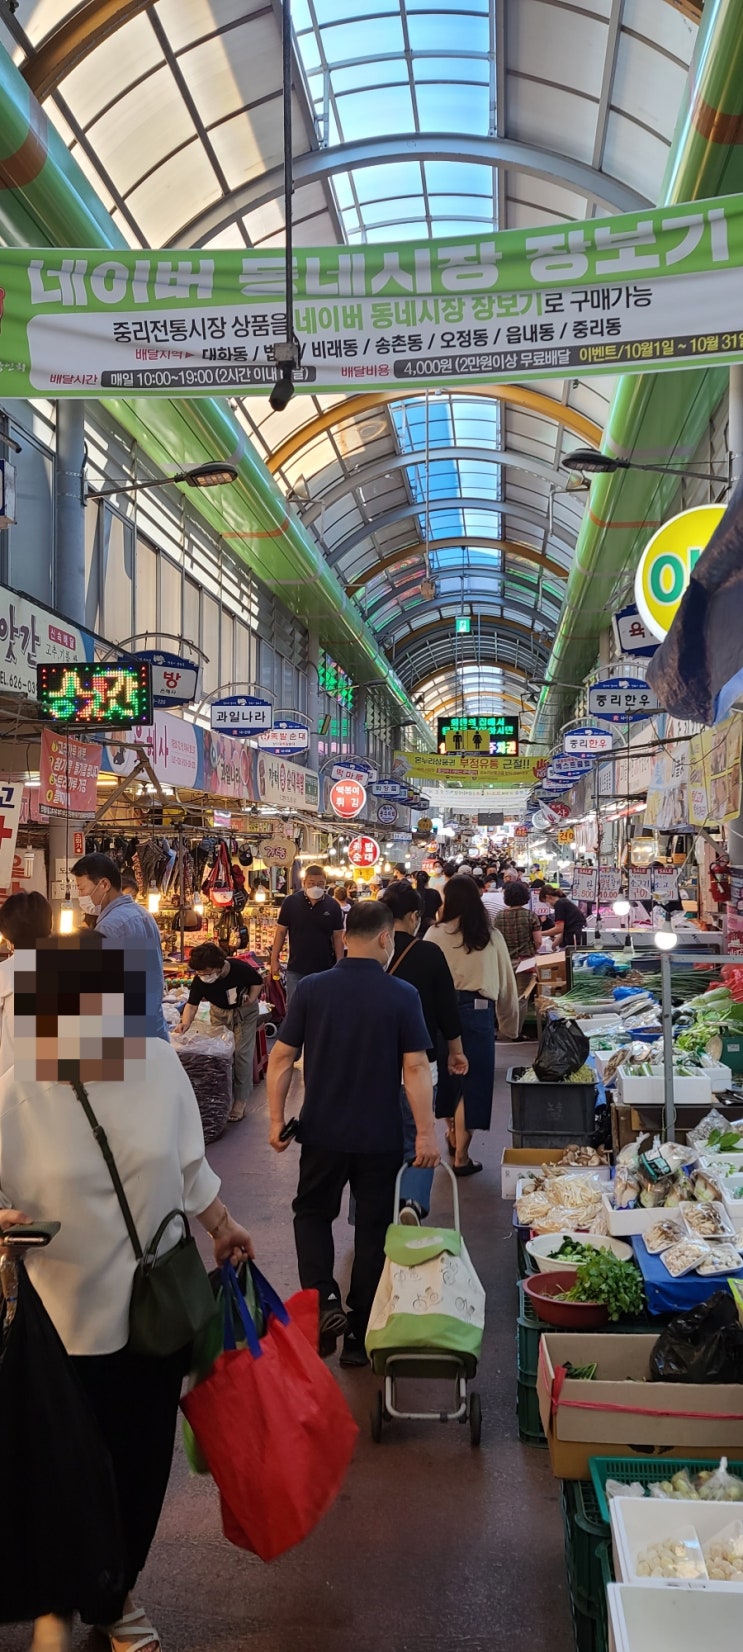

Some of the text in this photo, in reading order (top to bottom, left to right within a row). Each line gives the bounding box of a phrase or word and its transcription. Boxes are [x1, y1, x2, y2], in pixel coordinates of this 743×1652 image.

[27, 259, 215, 306] 네이버
[525, 207, 729, 283] 장보기
[113, 316, 226, 344] 중리전통시장
[231, 312, 289, 338] 상품을
[294, 304, 363, 334] 네이버
[371, 294, 465, 330] 동네시장
[570, 286, 652, 312] 구매가능
[202, 346, 248, 362] 대화동
[312, 340, 358, 359] 비래동
[375, 335, 423, 355] 송촌동
[440, 329, 489, 349] 오정동
[506, 323, 555, 344] 읍내동
[572, 318, 622, 339] 중리동
[341, 364, 390, 378] 배달비용
[404, 358, 453, 376] 4,000원
[520, 349, 571, 366] 무료배달
[689, 336, 719, 353] 10월
[49, 373, 98, 386] 배달시간
[110, 372, 135, 387] 매일
[50, 628, 75, 649] 신속배달
[596, 694, 650, 707] 중리한우
[216, 711, 266, 723] 과일나라
[569, 739, 607, 749] 중리한우
[460, 758, 499, 769] 부정유통
[503, 759, 530, 769] 근절!!
[335, 786, 360, 796] 떡볶이
